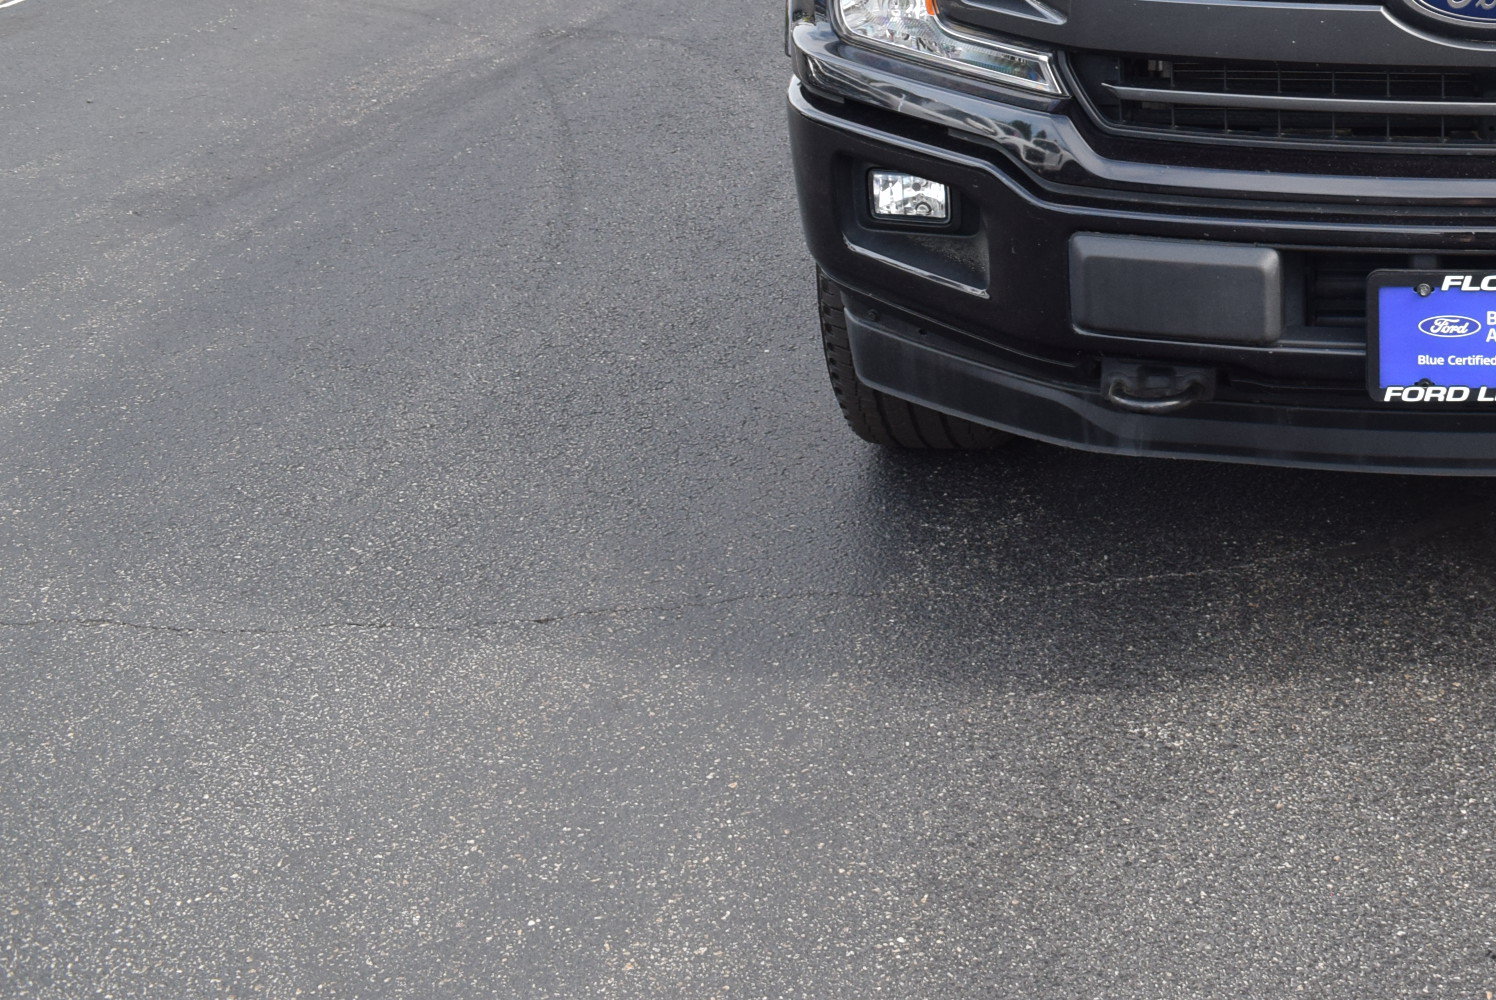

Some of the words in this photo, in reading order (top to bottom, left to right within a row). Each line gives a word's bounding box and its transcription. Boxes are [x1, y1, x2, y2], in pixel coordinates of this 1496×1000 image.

[1430, 317, 1470, 334] Ford
[1417, 355, 1444, 366] Blue
[1383, 386, 1470, 402] FORD
